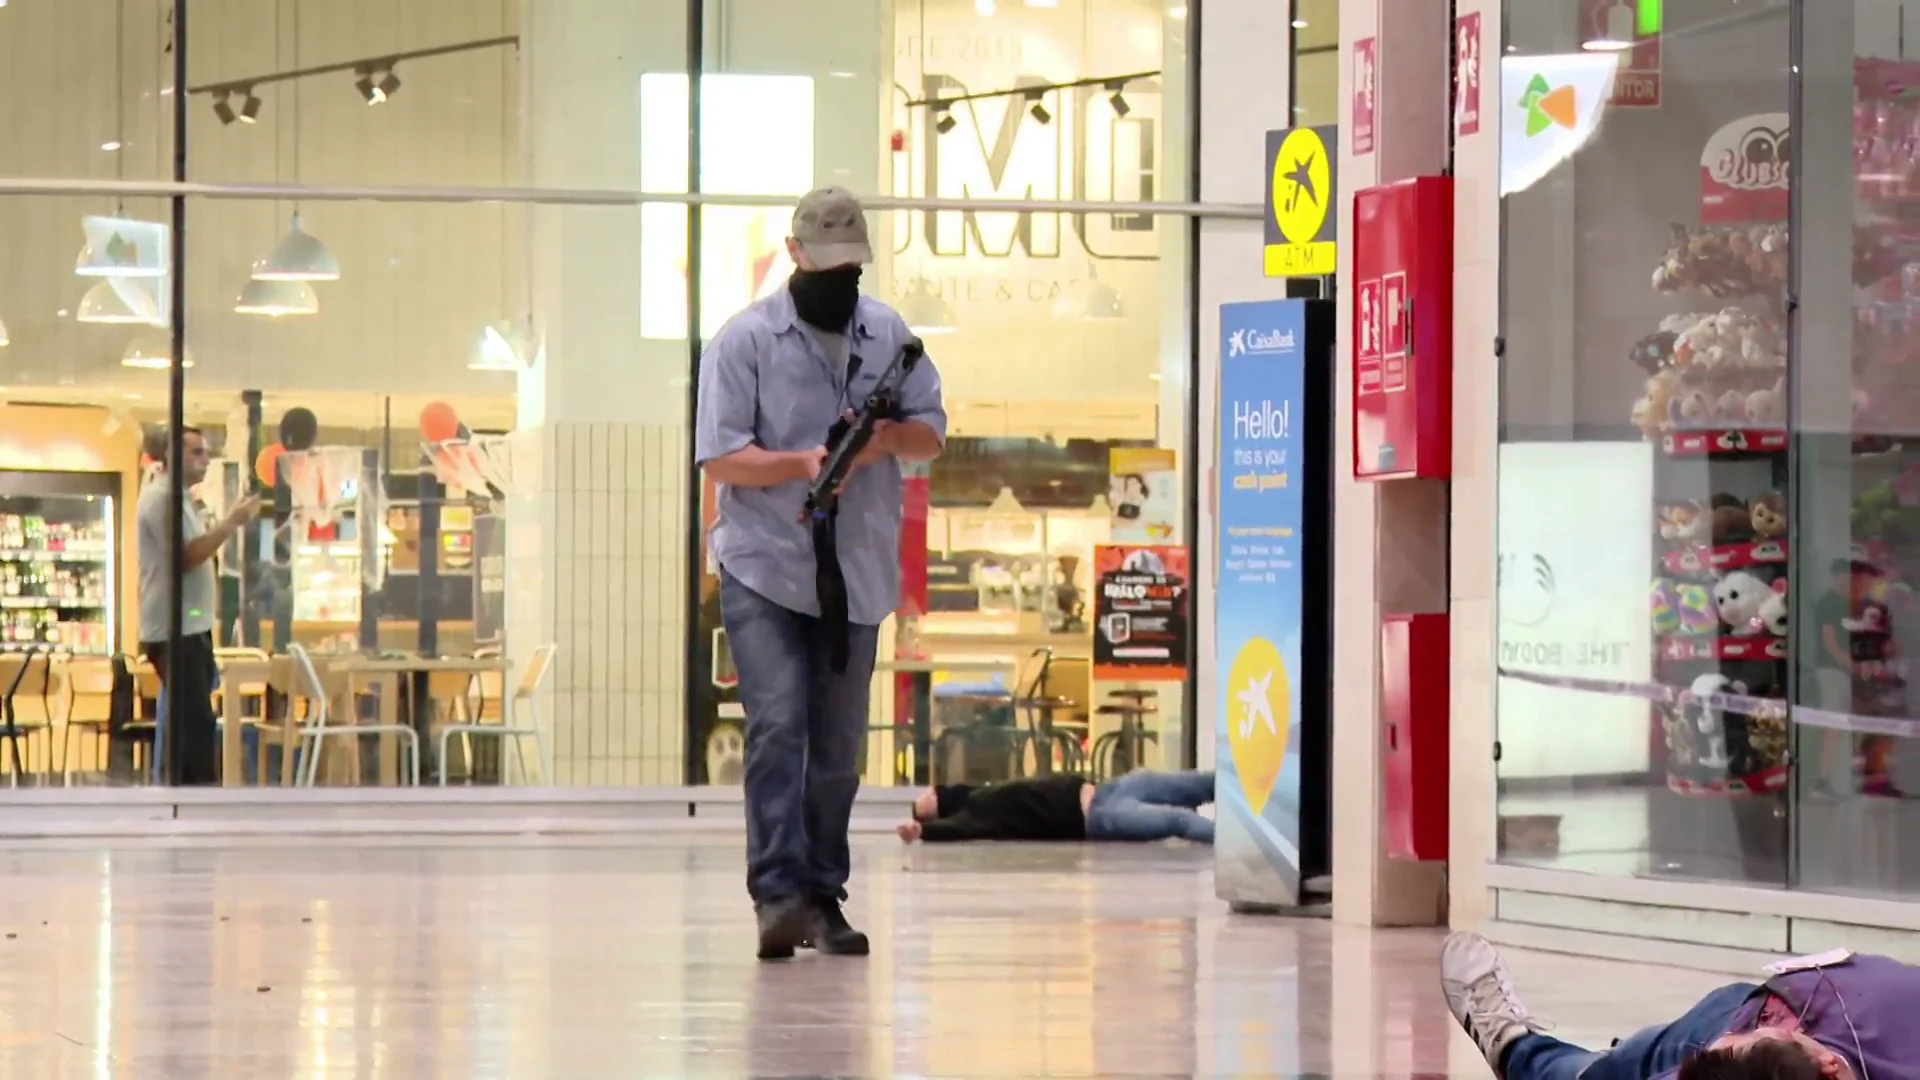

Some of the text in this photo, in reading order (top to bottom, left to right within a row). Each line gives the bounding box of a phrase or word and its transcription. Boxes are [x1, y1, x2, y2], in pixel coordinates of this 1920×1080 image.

[1284, 240, 1314, 269] ATM
[995, 277, 1012, 302] &
[1247, 328, 1295, 350] CaixaBank
[1234, 399, 1289, 440] Hello!
[1234, 449, 1288, 468] this is your
[1233, 469, 1288, 493] cash point
